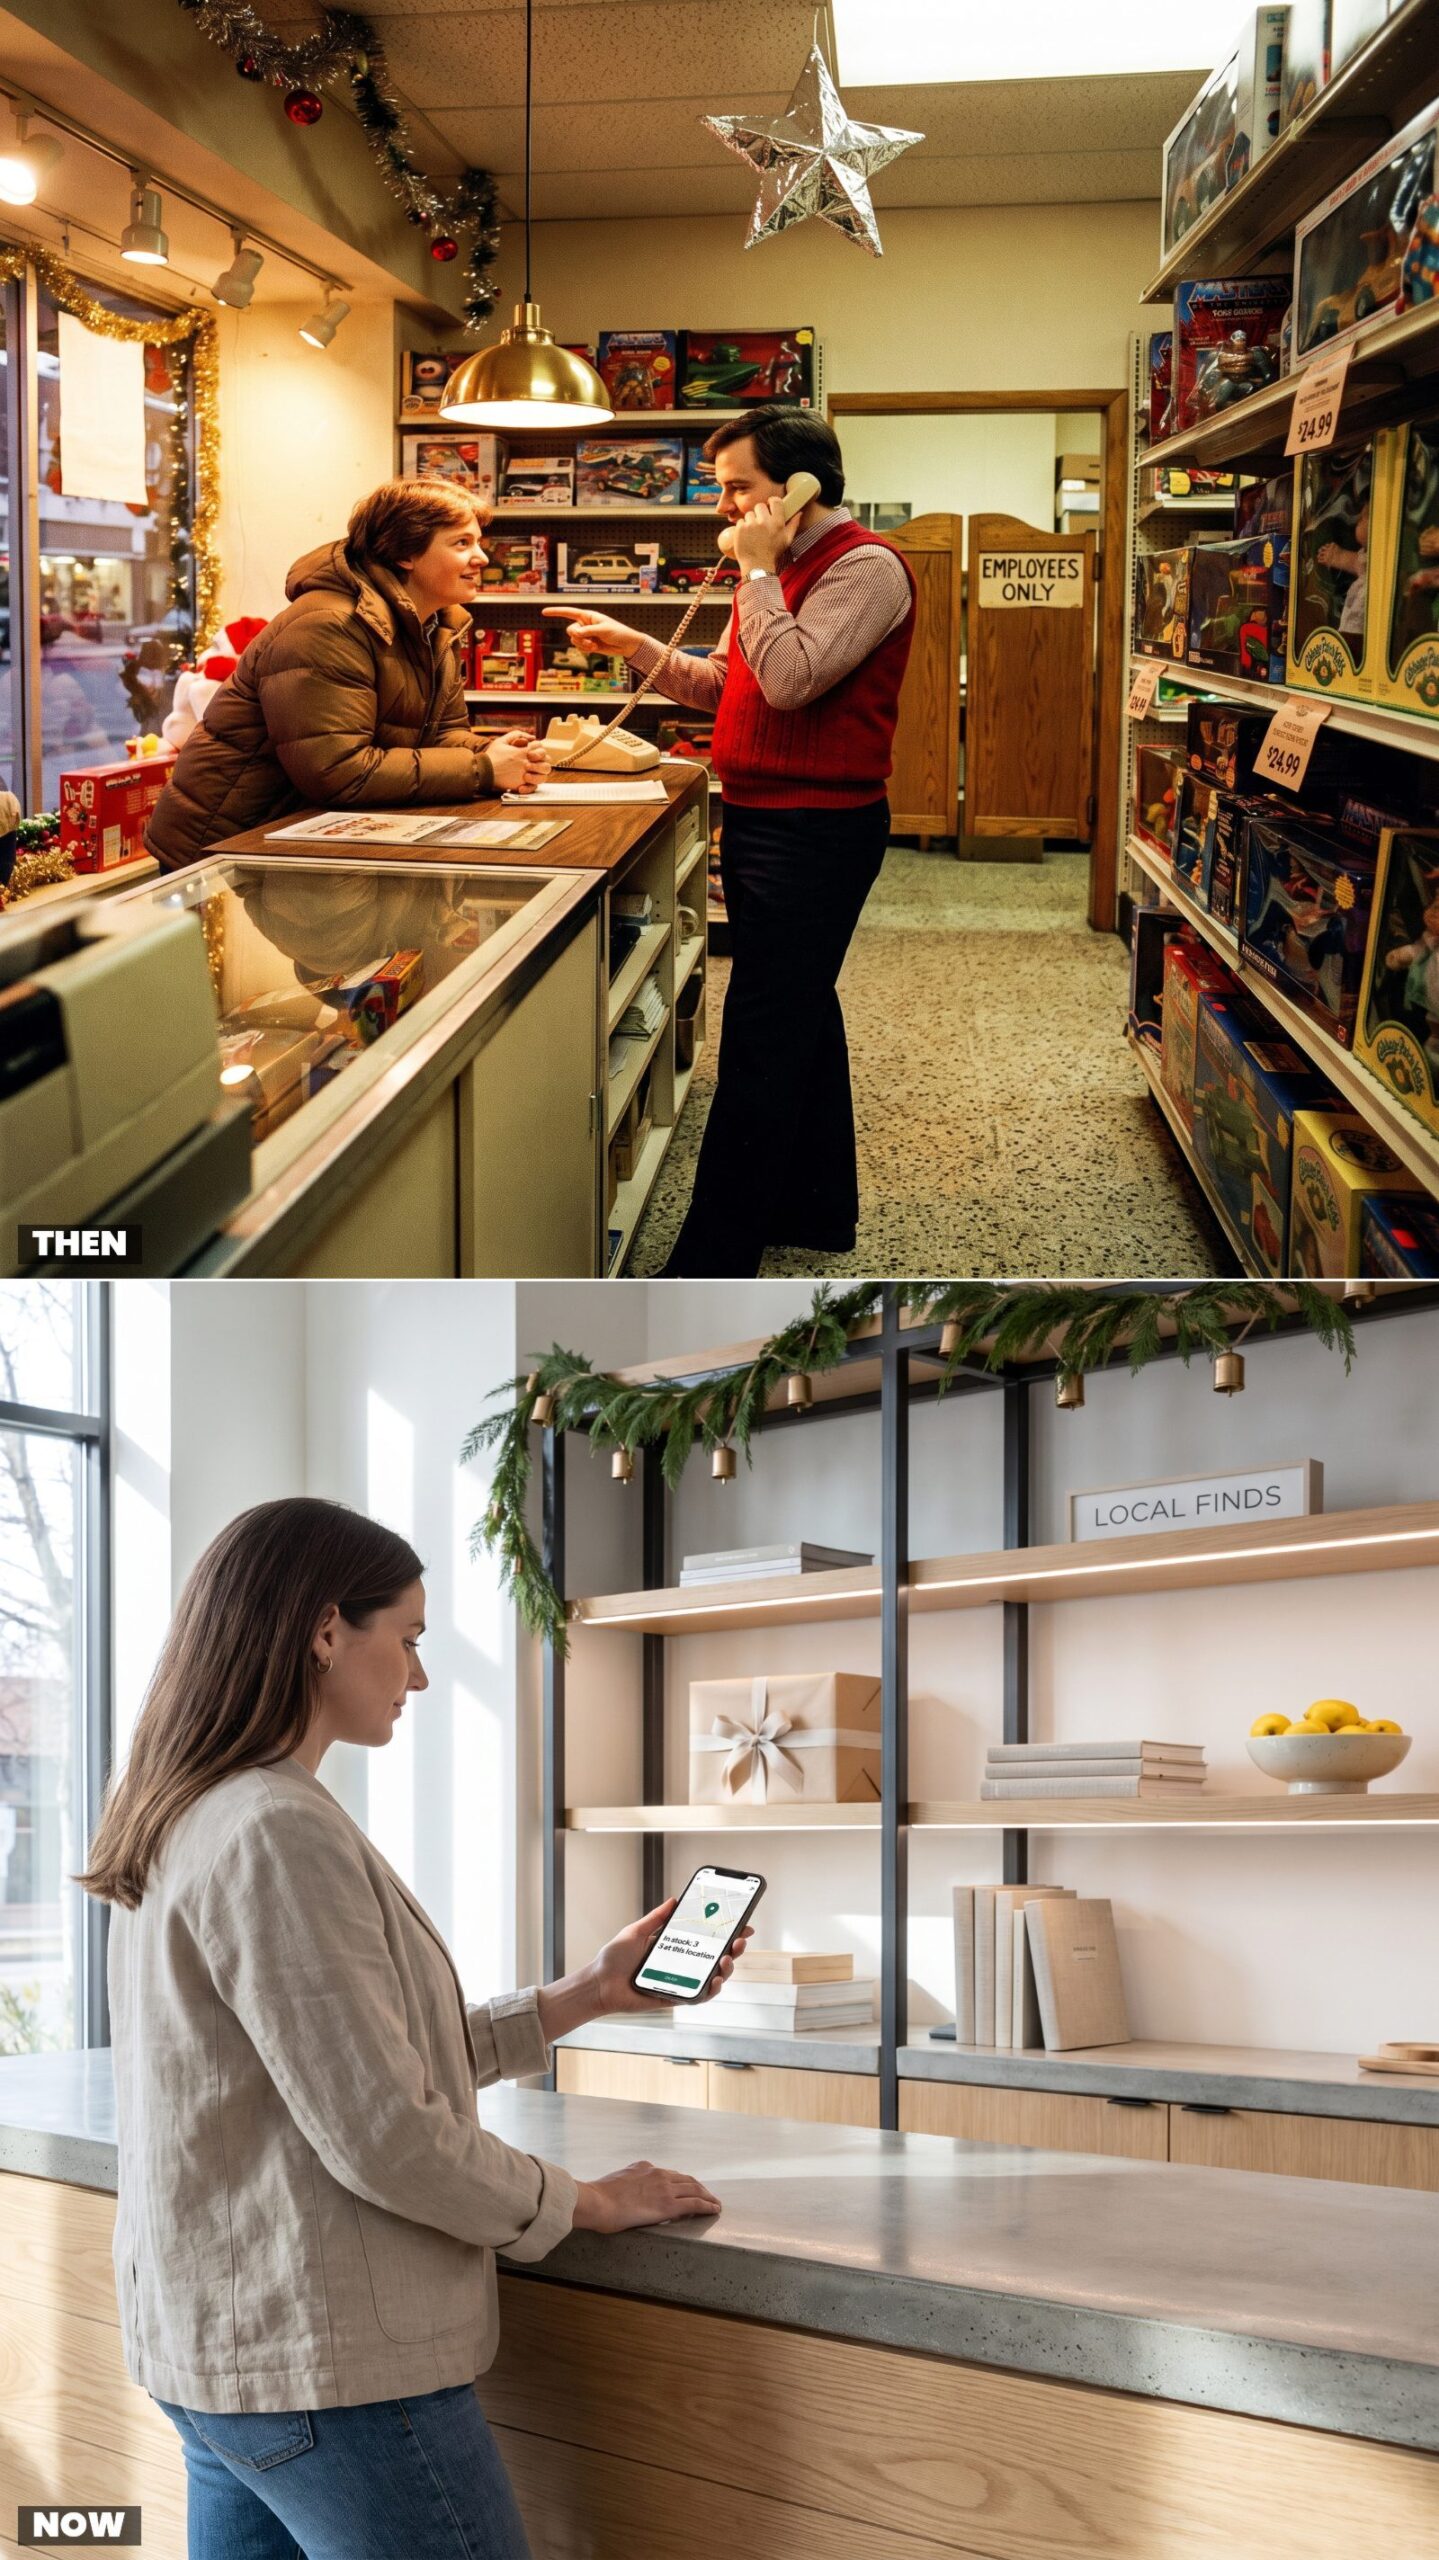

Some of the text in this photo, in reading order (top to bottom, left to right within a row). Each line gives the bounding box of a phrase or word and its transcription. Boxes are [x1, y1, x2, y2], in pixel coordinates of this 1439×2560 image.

[1298, 412, 1333, 443] $24.99
[982, 558, 1079, 579] EMPLOYEES
[1002, 582, 1055, 601] ONLY
[1267, 745, 1301, 778] $24.99
[1095, 1485, 1282, 1527] LOCAL FINDS
[685, 1948, 715, 1960] location
